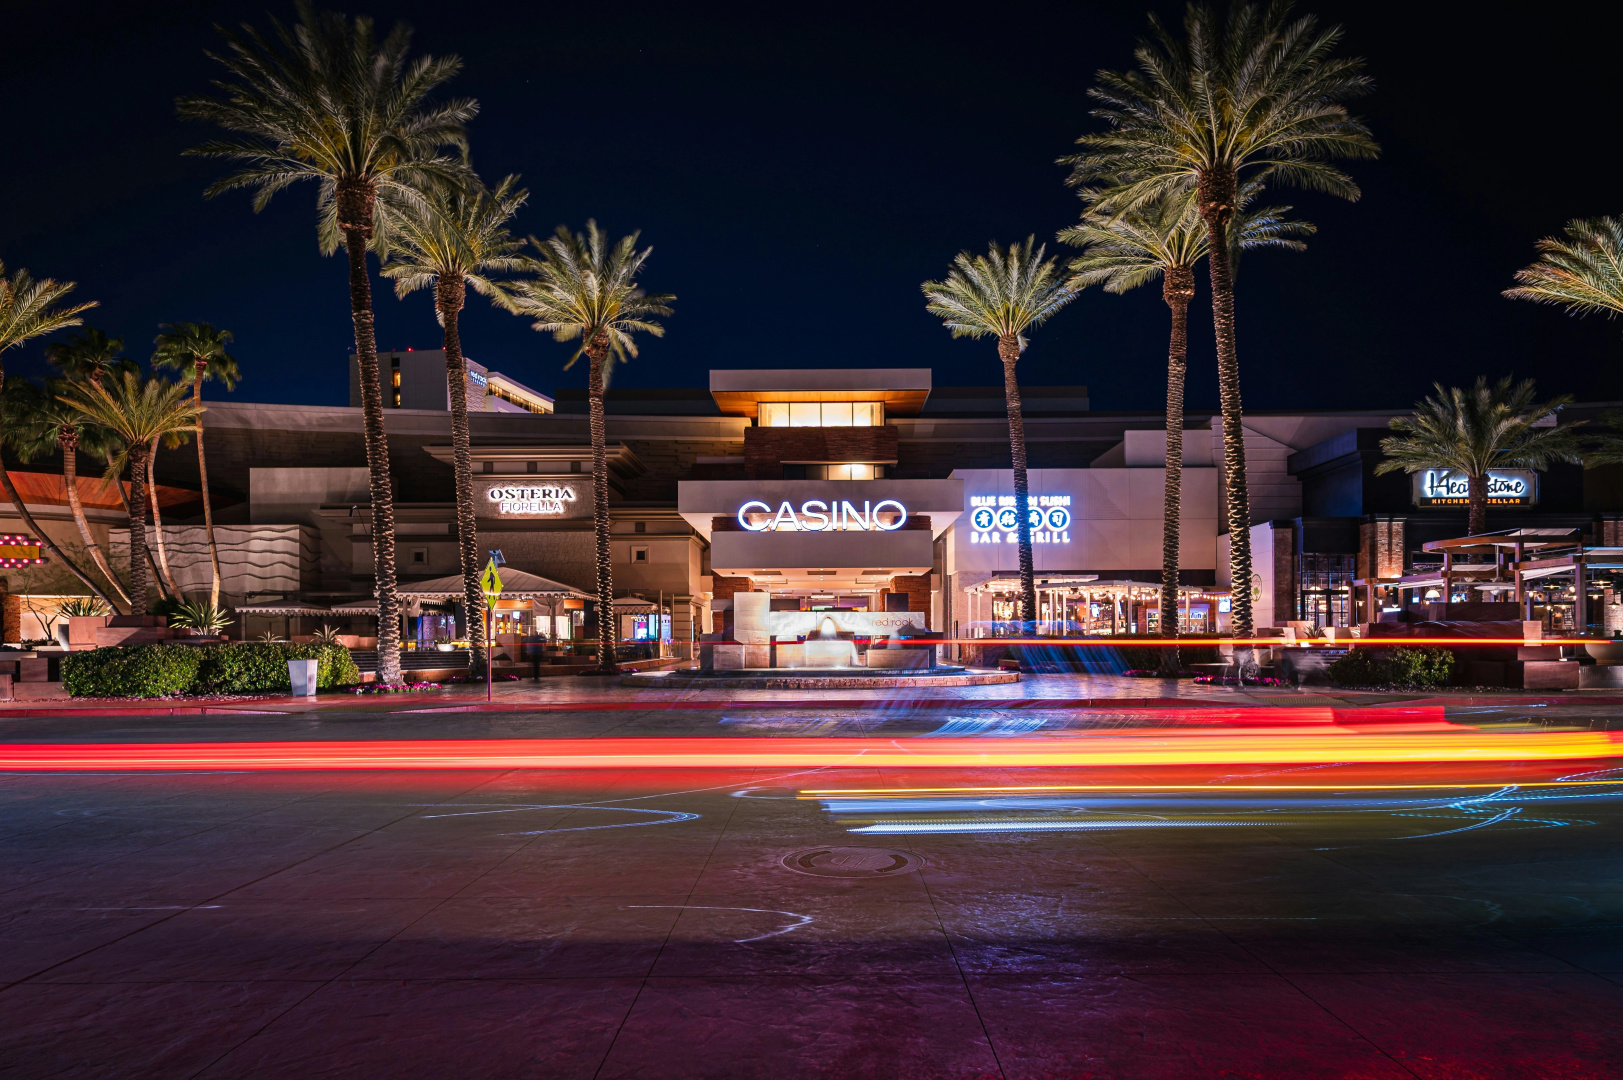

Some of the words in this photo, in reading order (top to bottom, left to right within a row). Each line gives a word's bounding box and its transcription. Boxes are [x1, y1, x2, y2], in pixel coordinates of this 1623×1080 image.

[1427, 471, 1525, 496] Heastone
[490, 488, 573, 499] OSTERIA
[970, 496, 997, 506] BLUE
[998, 496, 1038, 506] RIBN
[1040, 495, 1071, 506] SUSHI
[501, 502, 561, 511] FIORELLA
[738, 500, 907, 531] CASINO
[970, 531, 1001, 543] BAR
[871, 617, 889, 626] red
[891, 617, 914, 626] rock
